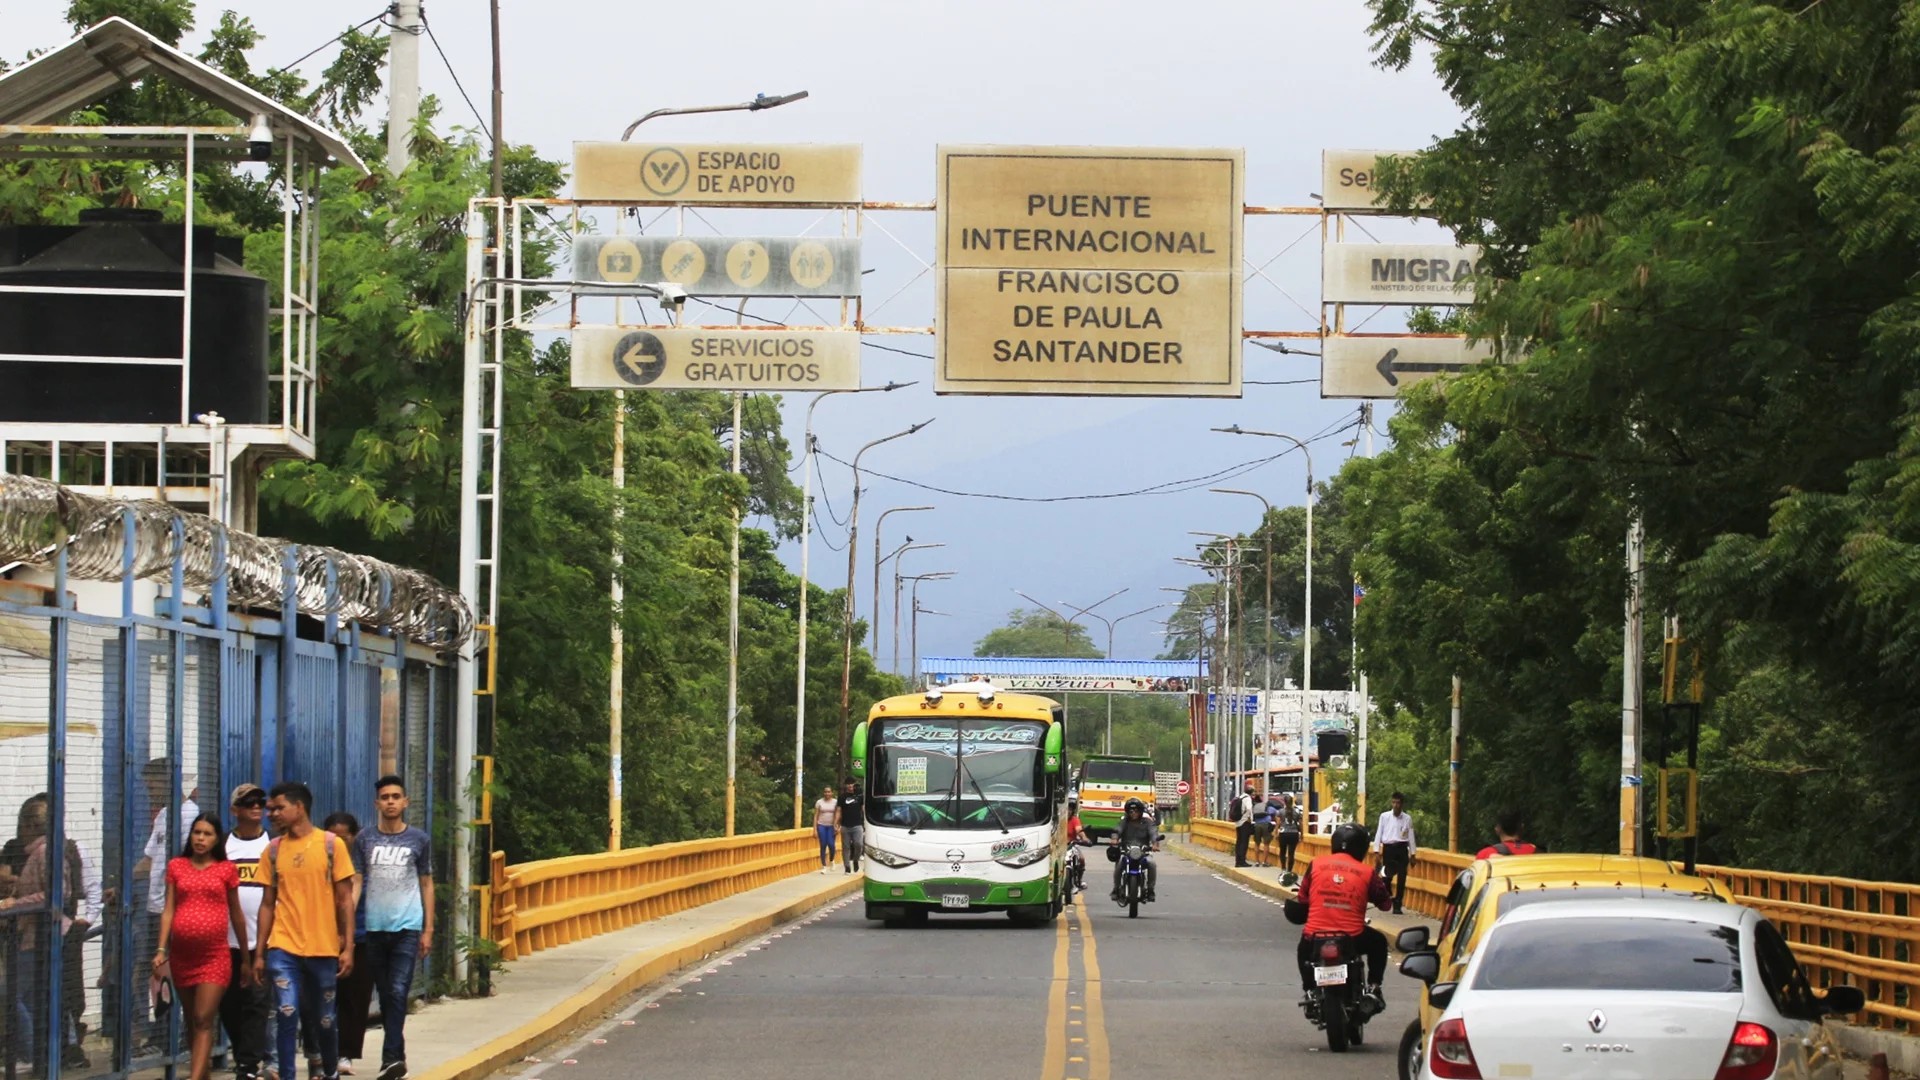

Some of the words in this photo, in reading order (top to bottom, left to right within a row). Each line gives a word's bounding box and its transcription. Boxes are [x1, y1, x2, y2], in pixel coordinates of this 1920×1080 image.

[698, 152, 780, 170] ESPACIO
[698, 175, 723, 193] DE
[729, 175, 795, 193] APOYO
[1027, 194, 1151, 218] PUENTE
[961, 228, 1216, 254] INTERNACIONAL
[1371, 258, 1477, 282] MIGRA
[997, 270, 1179, 295] FRANCISCO
[1371, 284, 1414, 292] MINISTERIO
[1415, 284, 1426, 292] DE
[1013, 305, 1054, 328] DE
[1063, 306, 1163, 329] PAULA
[691, 339, 814, 357] SERVICIOS
[993, 340, 1183, 364] SANTANDER
[685, 363, 820, 382] GRATUITOS
[1010, 679, 1115, 689] VENEZUELA
[238, 866, 258, 879] BV
